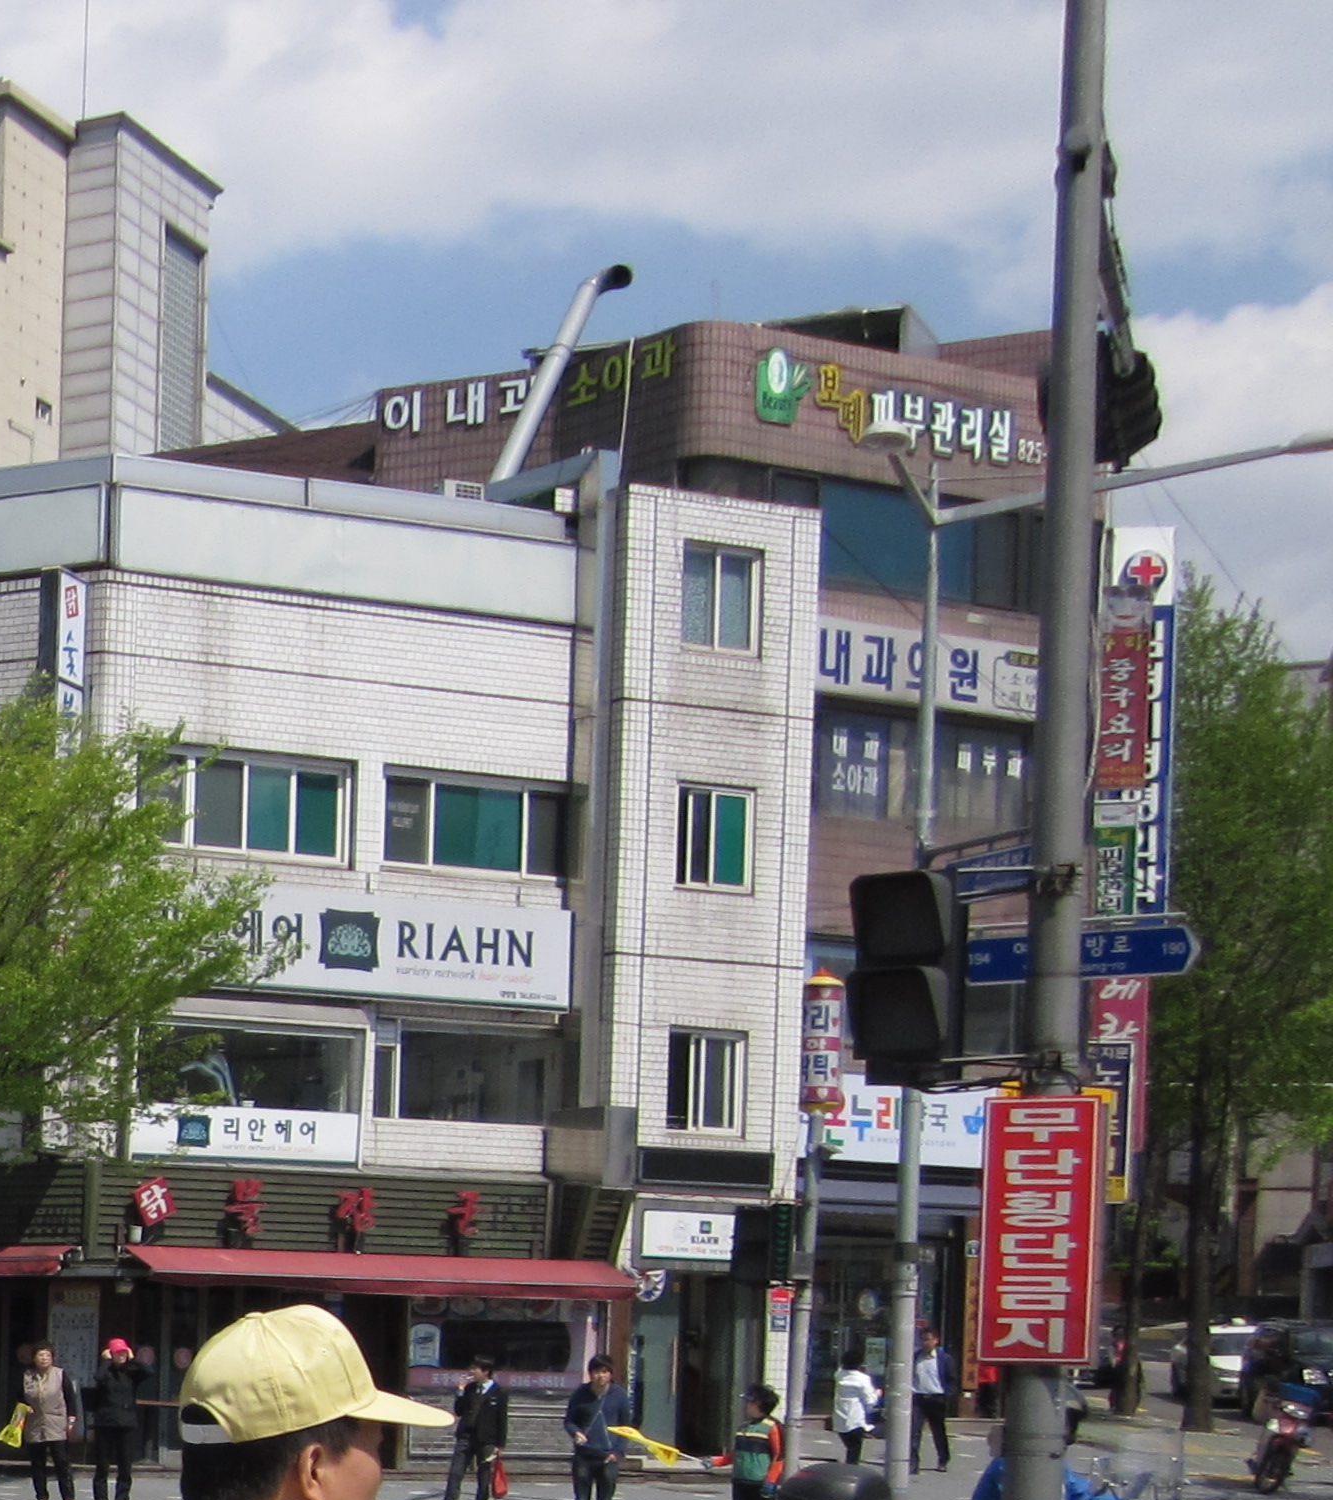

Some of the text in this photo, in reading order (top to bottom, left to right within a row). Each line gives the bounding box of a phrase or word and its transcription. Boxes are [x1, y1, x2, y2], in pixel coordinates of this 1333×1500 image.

[871, 390, 1013, 465] 피부관리실
[1102, 658, 1136, 763] 중국요리
[832, 763, 879, 797] 소아과
[396, 921, 534, 967] RIAHN
[434, 968, 477, 980] network
[223, 1117, 318, 1144] 리안헤어
[994, 1107, 1081, 1354] 무단횡단금지
